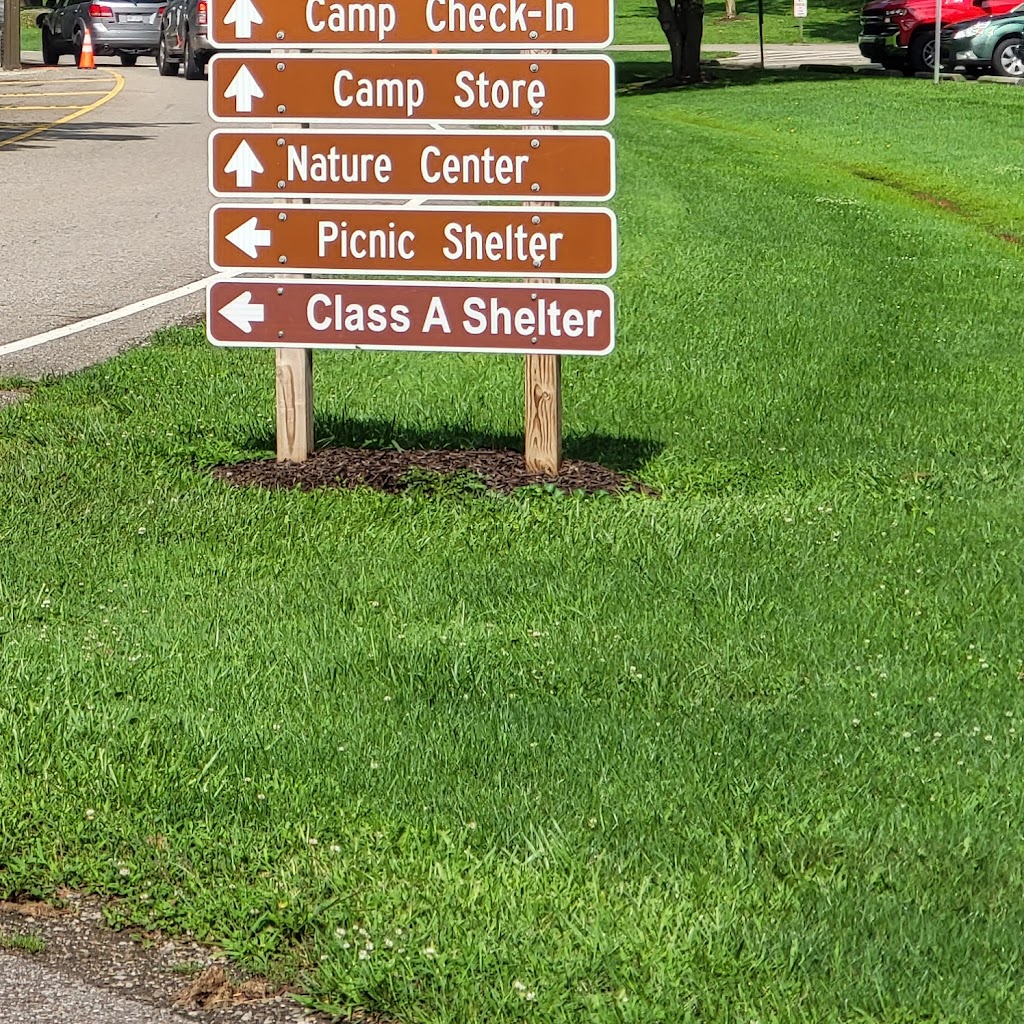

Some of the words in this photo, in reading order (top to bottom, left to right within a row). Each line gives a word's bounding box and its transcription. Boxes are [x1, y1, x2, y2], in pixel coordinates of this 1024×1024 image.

[333, 70, 424, 117] Camp
[455, 71, 545, 110] Store
[288, 145, 391, 182] Nature
[421, 146, 529, 184] Center
[319, 221, 415, 260] Picnic
[443, 222, 563, 262] Shelter
[307, 294, 410, 333] Class
[422, 297, 451, 333] A
[463, 294, 602, 339] Shelter
